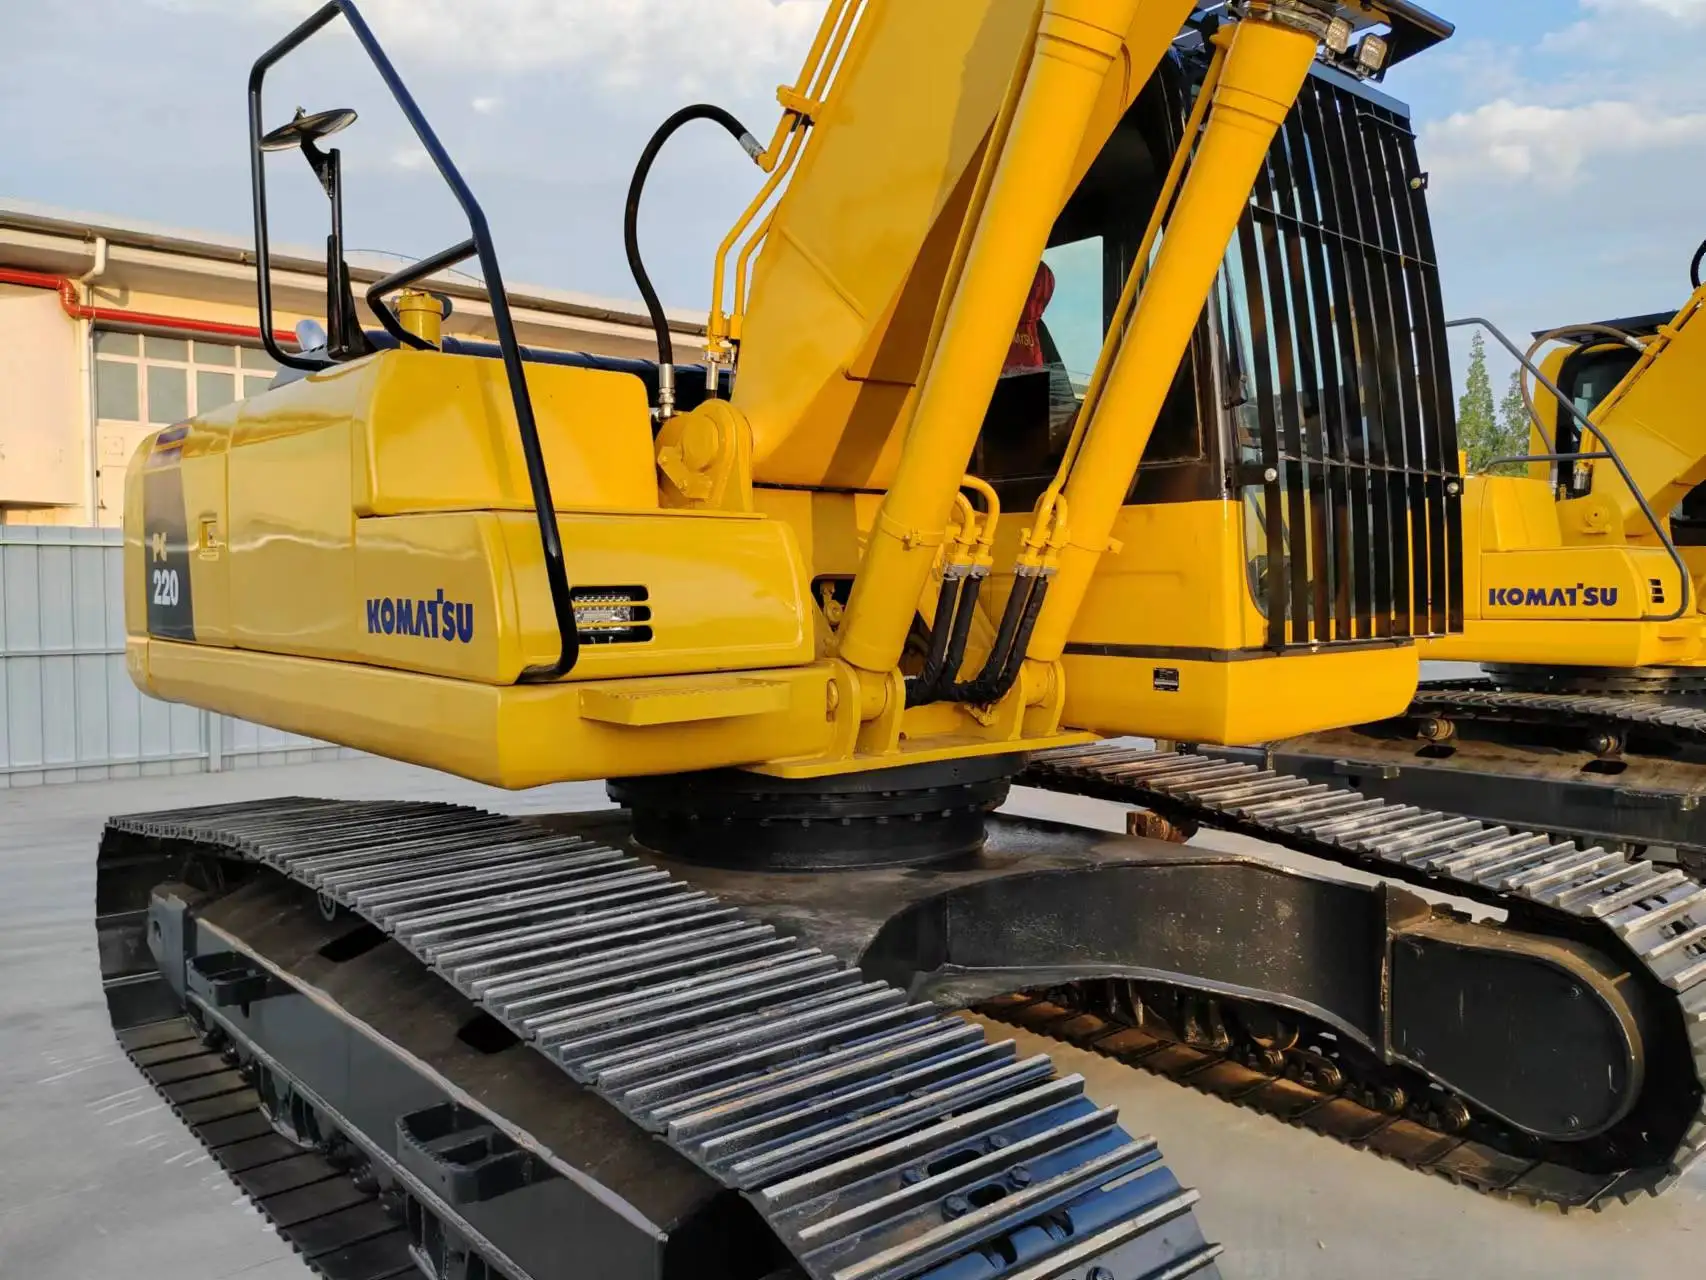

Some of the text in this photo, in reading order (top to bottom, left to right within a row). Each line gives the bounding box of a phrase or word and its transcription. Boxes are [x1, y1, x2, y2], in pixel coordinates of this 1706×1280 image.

[153, 569, 179, 606] 220
[1488, 582, 1618, 606] KOMATSU
[366, 588, 473, 643] KOMATSU
